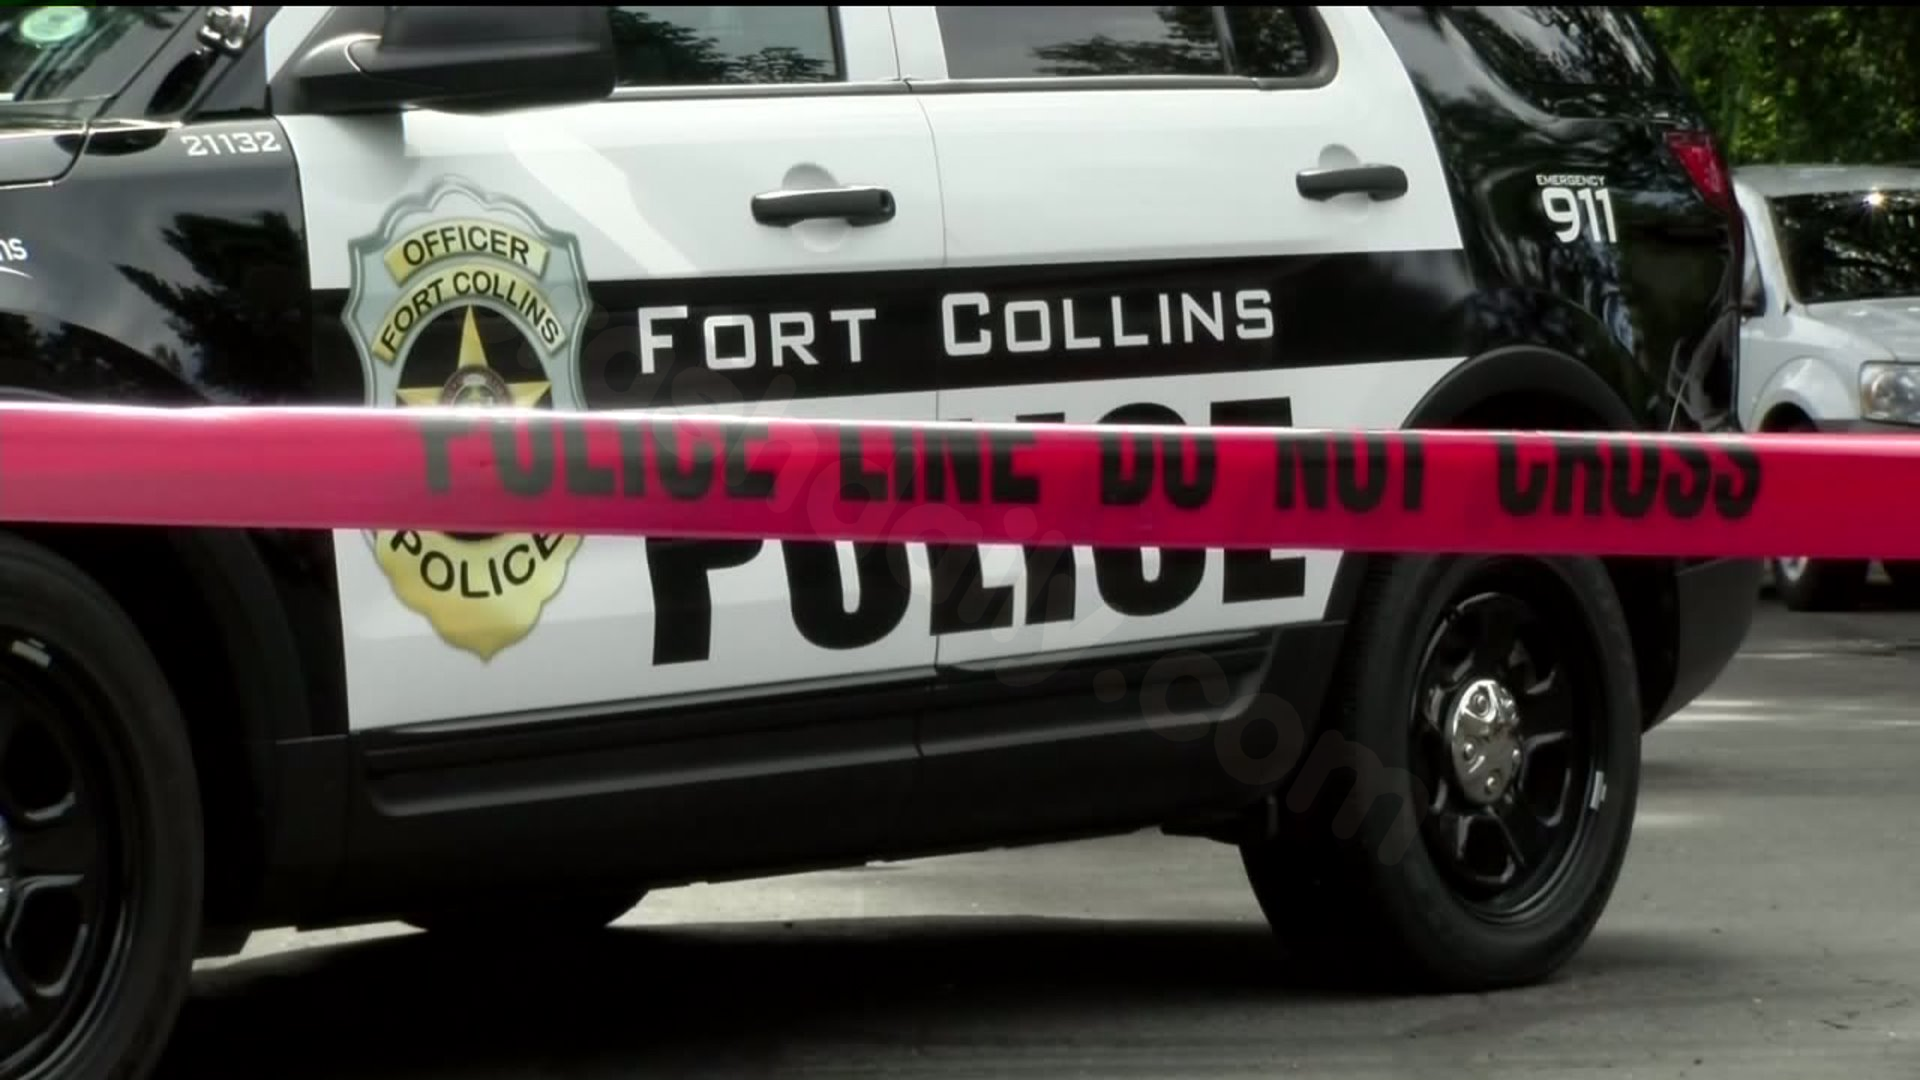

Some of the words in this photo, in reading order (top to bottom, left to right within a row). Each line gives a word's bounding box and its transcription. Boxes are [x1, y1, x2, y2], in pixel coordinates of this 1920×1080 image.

[181, 131, 281, 157] 21132
[1536, 174, 1605, 186] EMERGENCY
[402, 225, 530, 267] OFFICER
[1541, 186, 1617, 243] 911
[380, 271, 445, 354] FORT
[453, 270, 559, 345] COLLINS
[638, 304, 878, 375] FORT
[941, 289, 1276, 358] COLLINS
[418, 414, 778, 501] POLICE
[838, 420, 1041, 505] LINE
[1100, 430, 1217, 509] DO
[1275, 430, 1425, 515] NOT
[390, 529, 565, 598] POLICE
